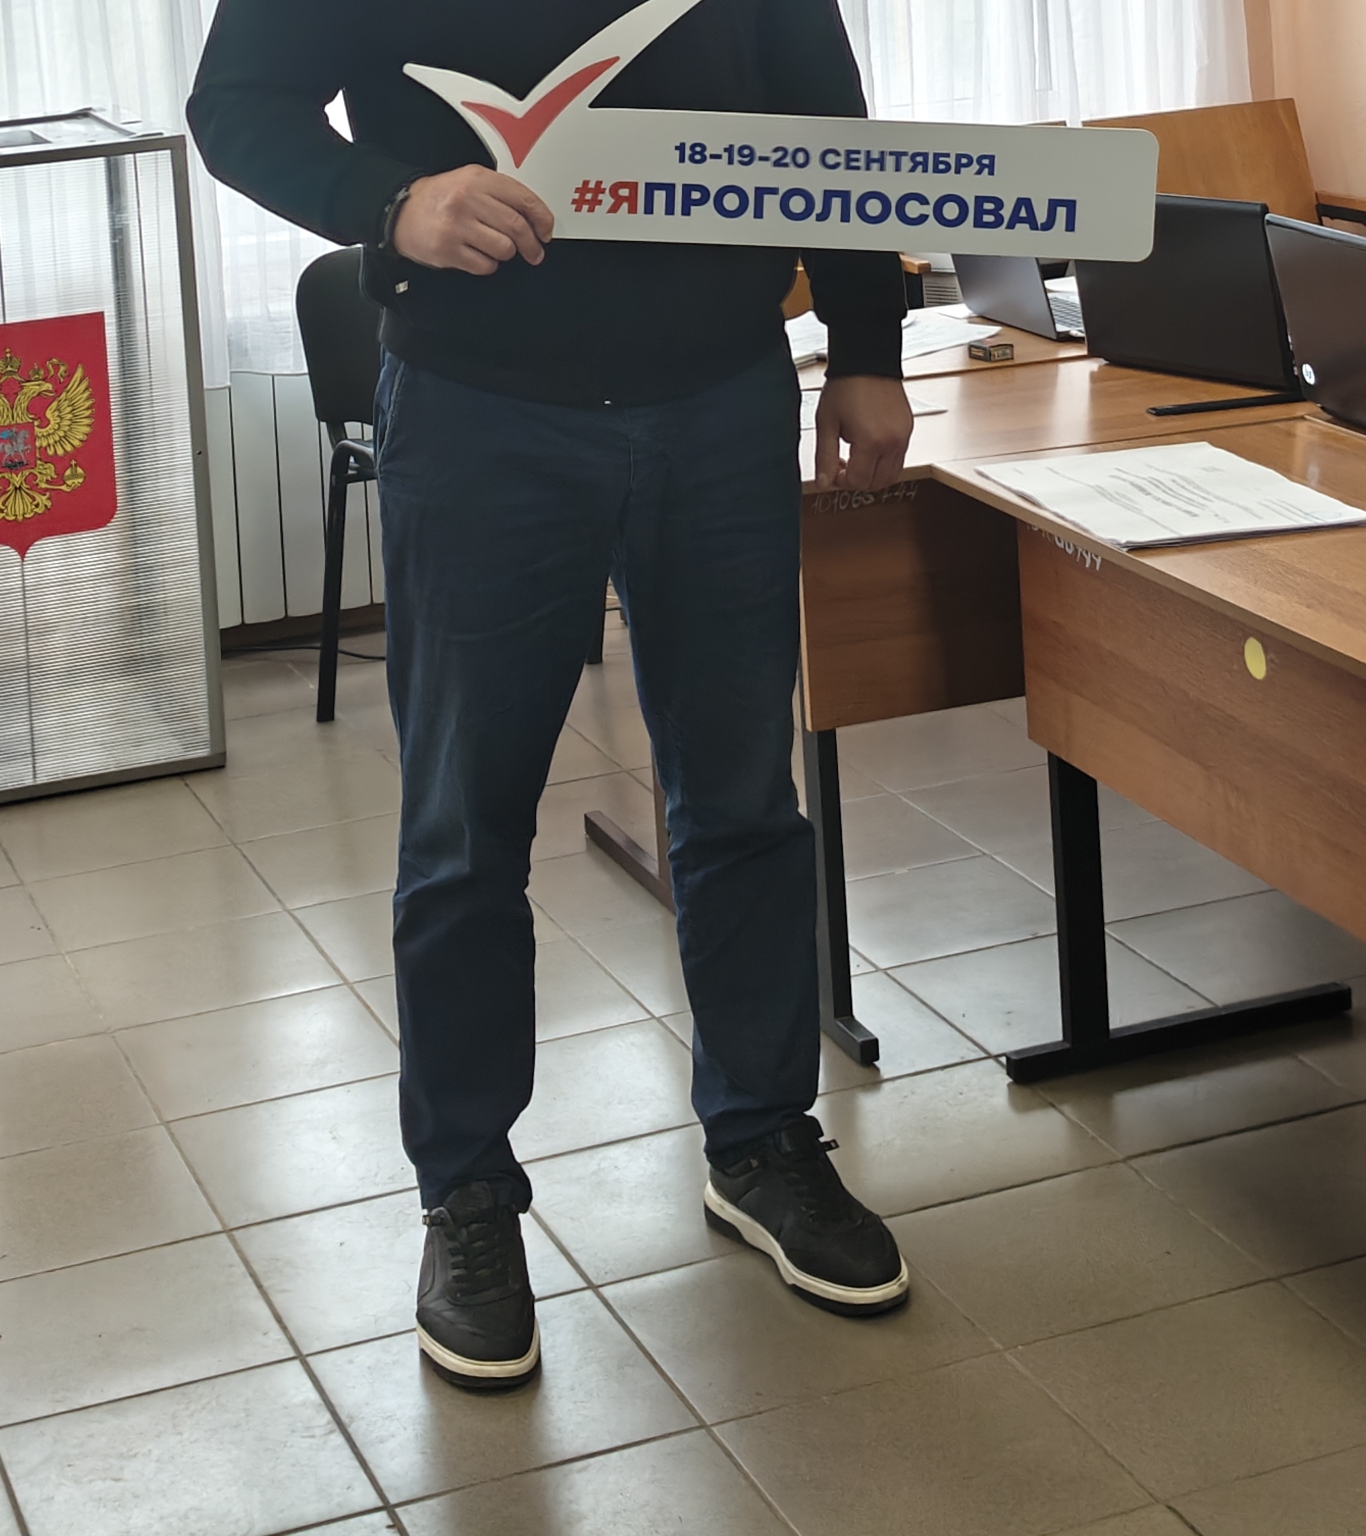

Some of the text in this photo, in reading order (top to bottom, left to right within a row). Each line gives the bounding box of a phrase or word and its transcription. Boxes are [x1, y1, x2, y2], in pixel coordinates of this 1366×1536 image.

[674, 141, 996, 176] 18-19-20 СЕНТЯБРЯ
[571, 179, 1078, 233] #ЯПРОГОЛОСОВАЛ
